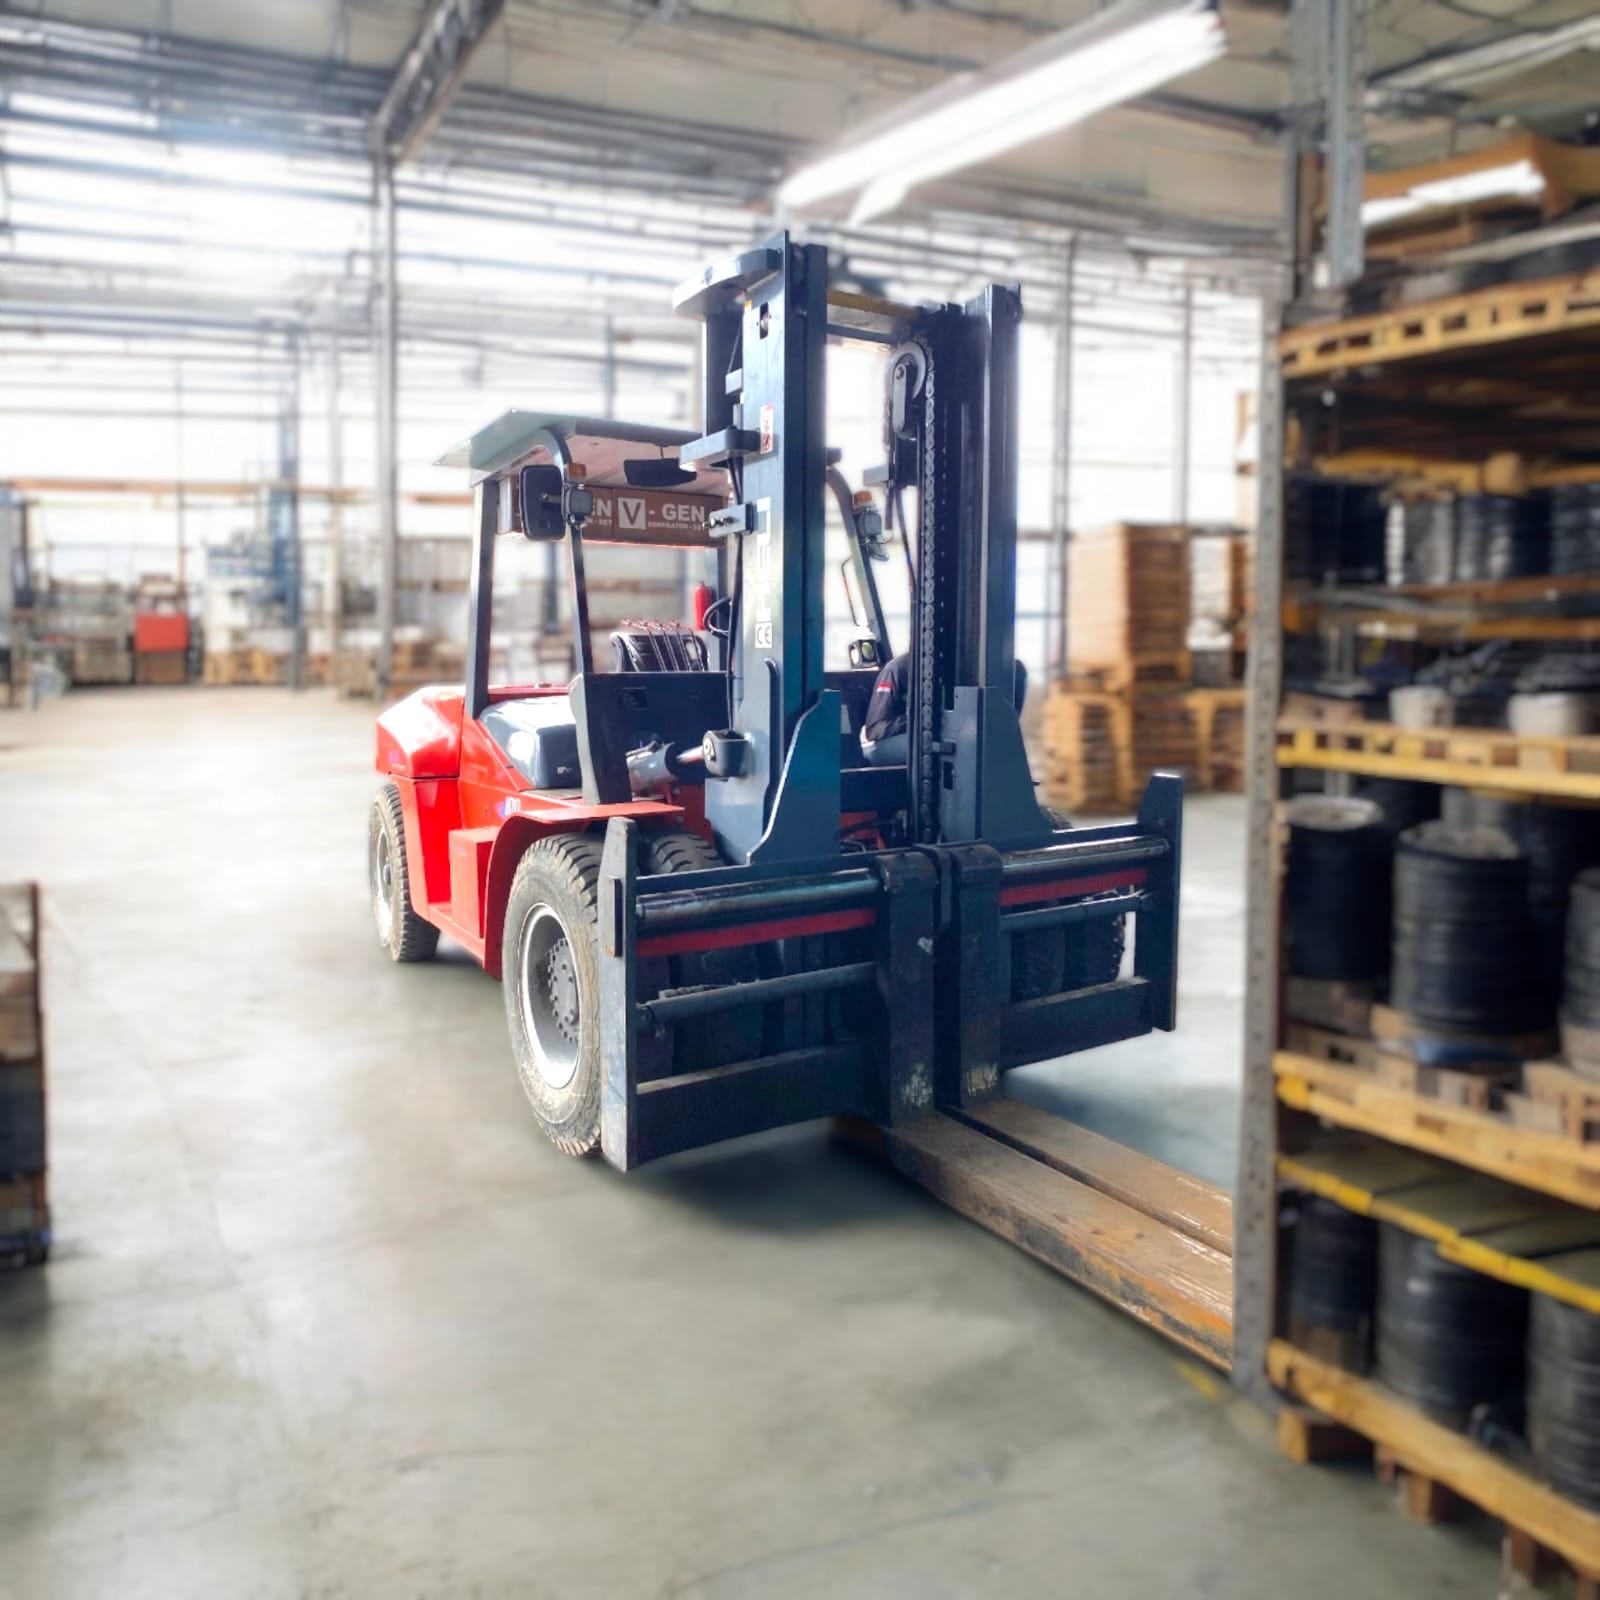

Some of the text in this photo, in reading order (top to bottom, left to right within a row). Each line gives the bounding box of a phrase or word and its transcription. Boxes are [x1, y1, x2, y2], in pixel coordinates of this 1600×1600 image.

[620, 499, 643, 527] V
[662, 503, 705, 522] GEN
[756, 625, 771, 646] CE
